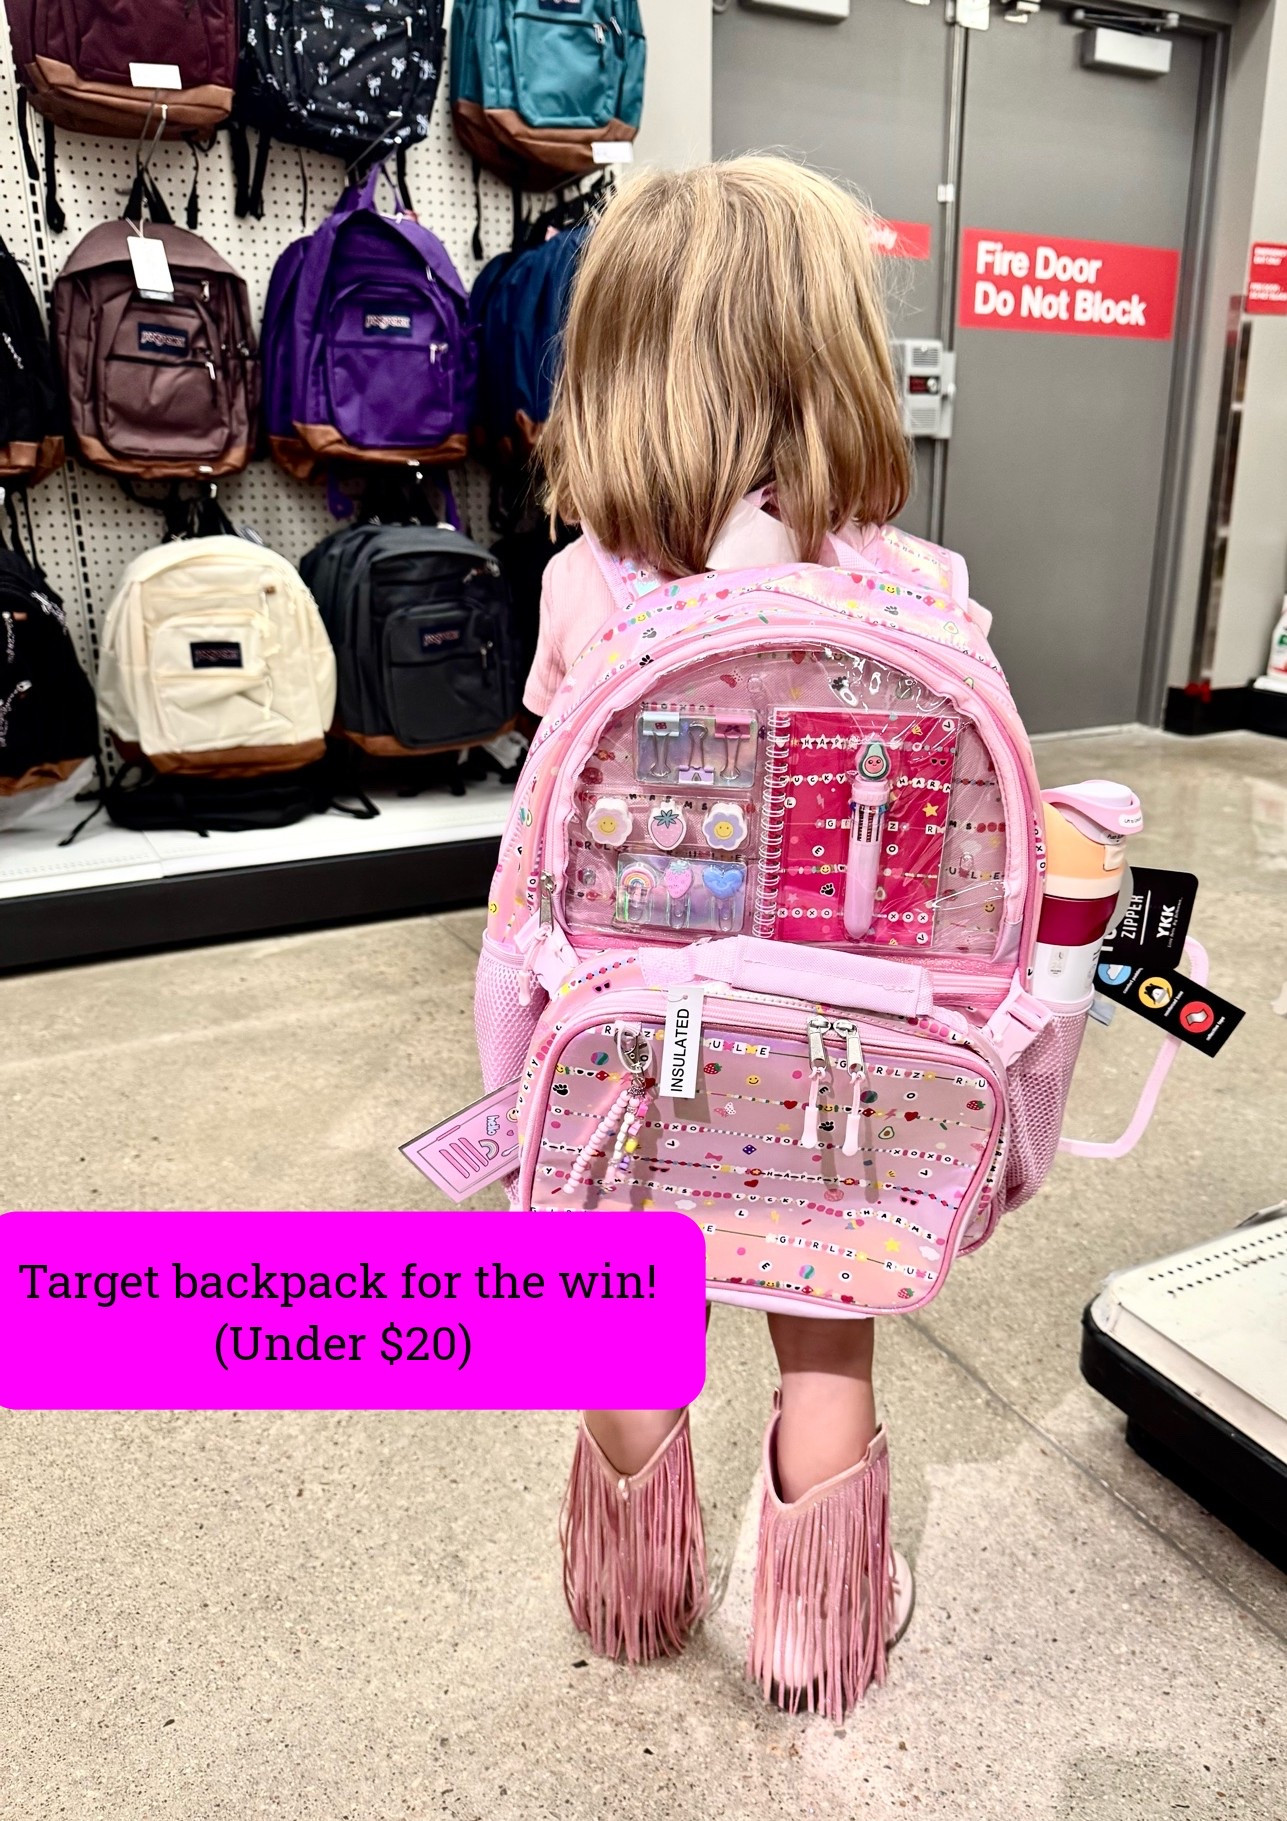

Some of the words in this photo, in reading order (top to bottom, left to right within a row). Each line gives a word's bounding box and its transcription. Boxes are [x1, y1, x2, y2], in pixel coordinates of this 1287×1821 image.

[975, 240, 1031, 277] Fire
[1035, 245, 1103, 284] Door
[973, 280, 1015, 317] Do
[1020, 284, 1071, 320] Not
[1074, 289, 1147, 327] Block
[1120, 895, 1145, 940] ZIPPER
[1156, 904, 1176, 938] YKK
[671, 1008, 690, 1093] INSULATED
[711, 1040, 769, 1056] ULE
[839, 1060, 921, 1079] GRLZ
[735, 1193, 806, 1207] LUCKY
[846, 1208, 933, 1240] CHARMS
[778, 1235, 854, 1258] GIRLZ
